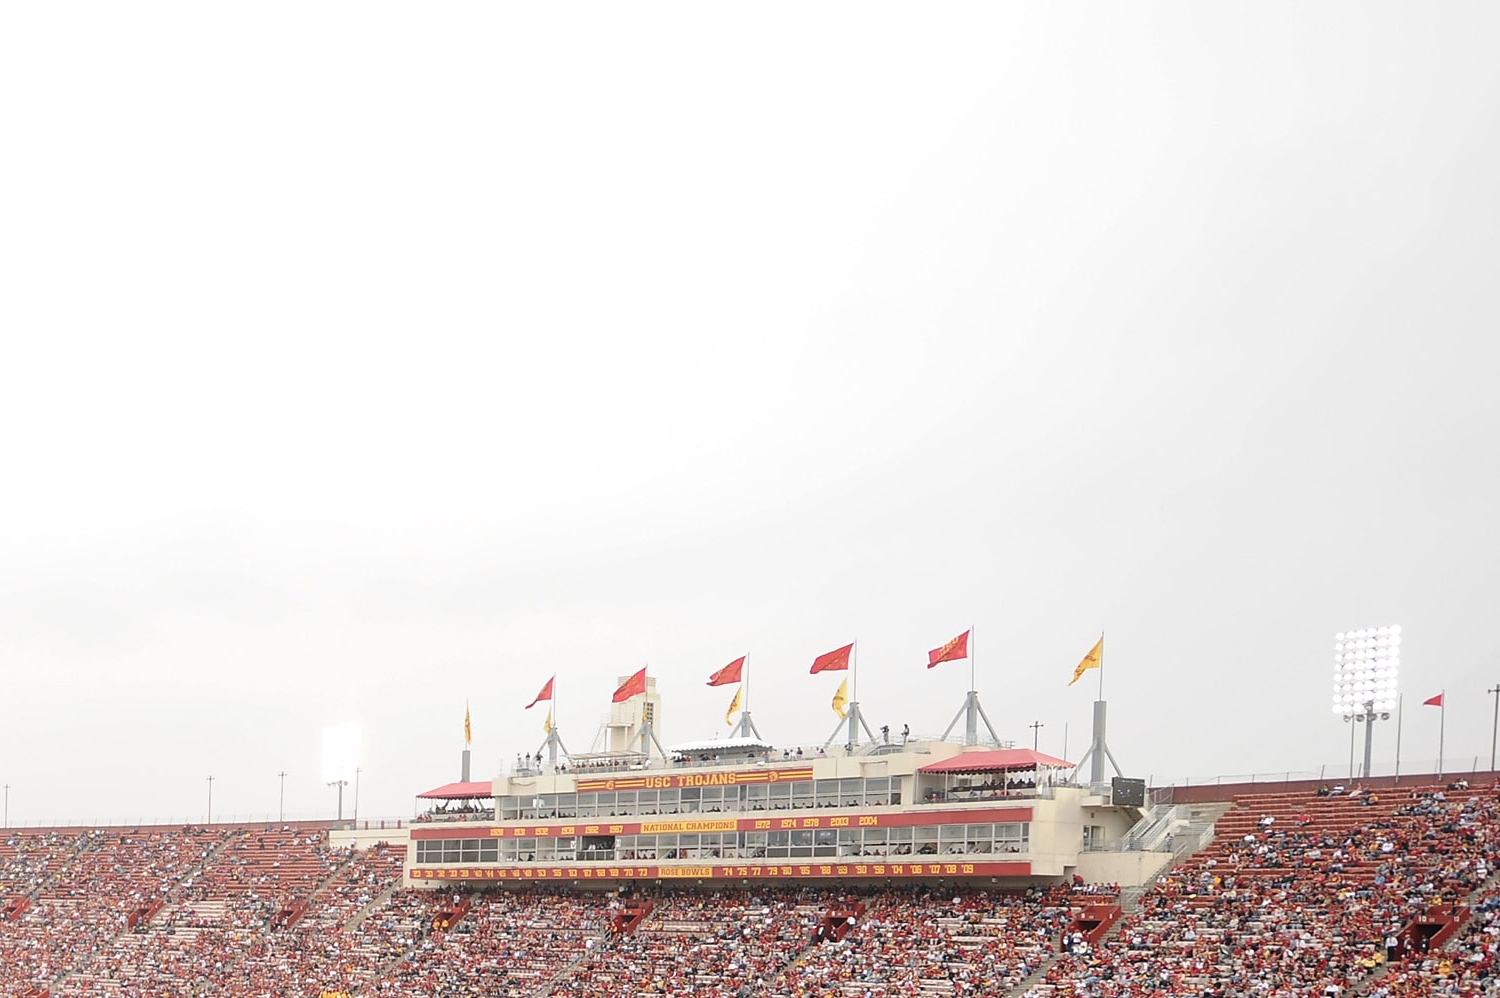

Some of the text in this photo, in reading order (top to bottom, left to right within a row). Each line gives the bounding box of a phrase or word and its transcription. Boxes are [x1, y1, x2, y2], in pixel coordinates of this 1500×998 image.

[646, 773, 736, 788] USC TROJANS
[643, 823, 683, 832] NATIONAL
[686, 821, 735, 831] CHAMPIONS
[755, 820, 770, 829] 1972
[781, 819, 796, 828] 1974
[803, 818, 819, 827] 1978
[830, 817, 848, 826] 2003
[859, 816, 877, 825] 2004
[661, 868, 679, 876] ROSE
[681, 868, 710, 876] BOWLS
